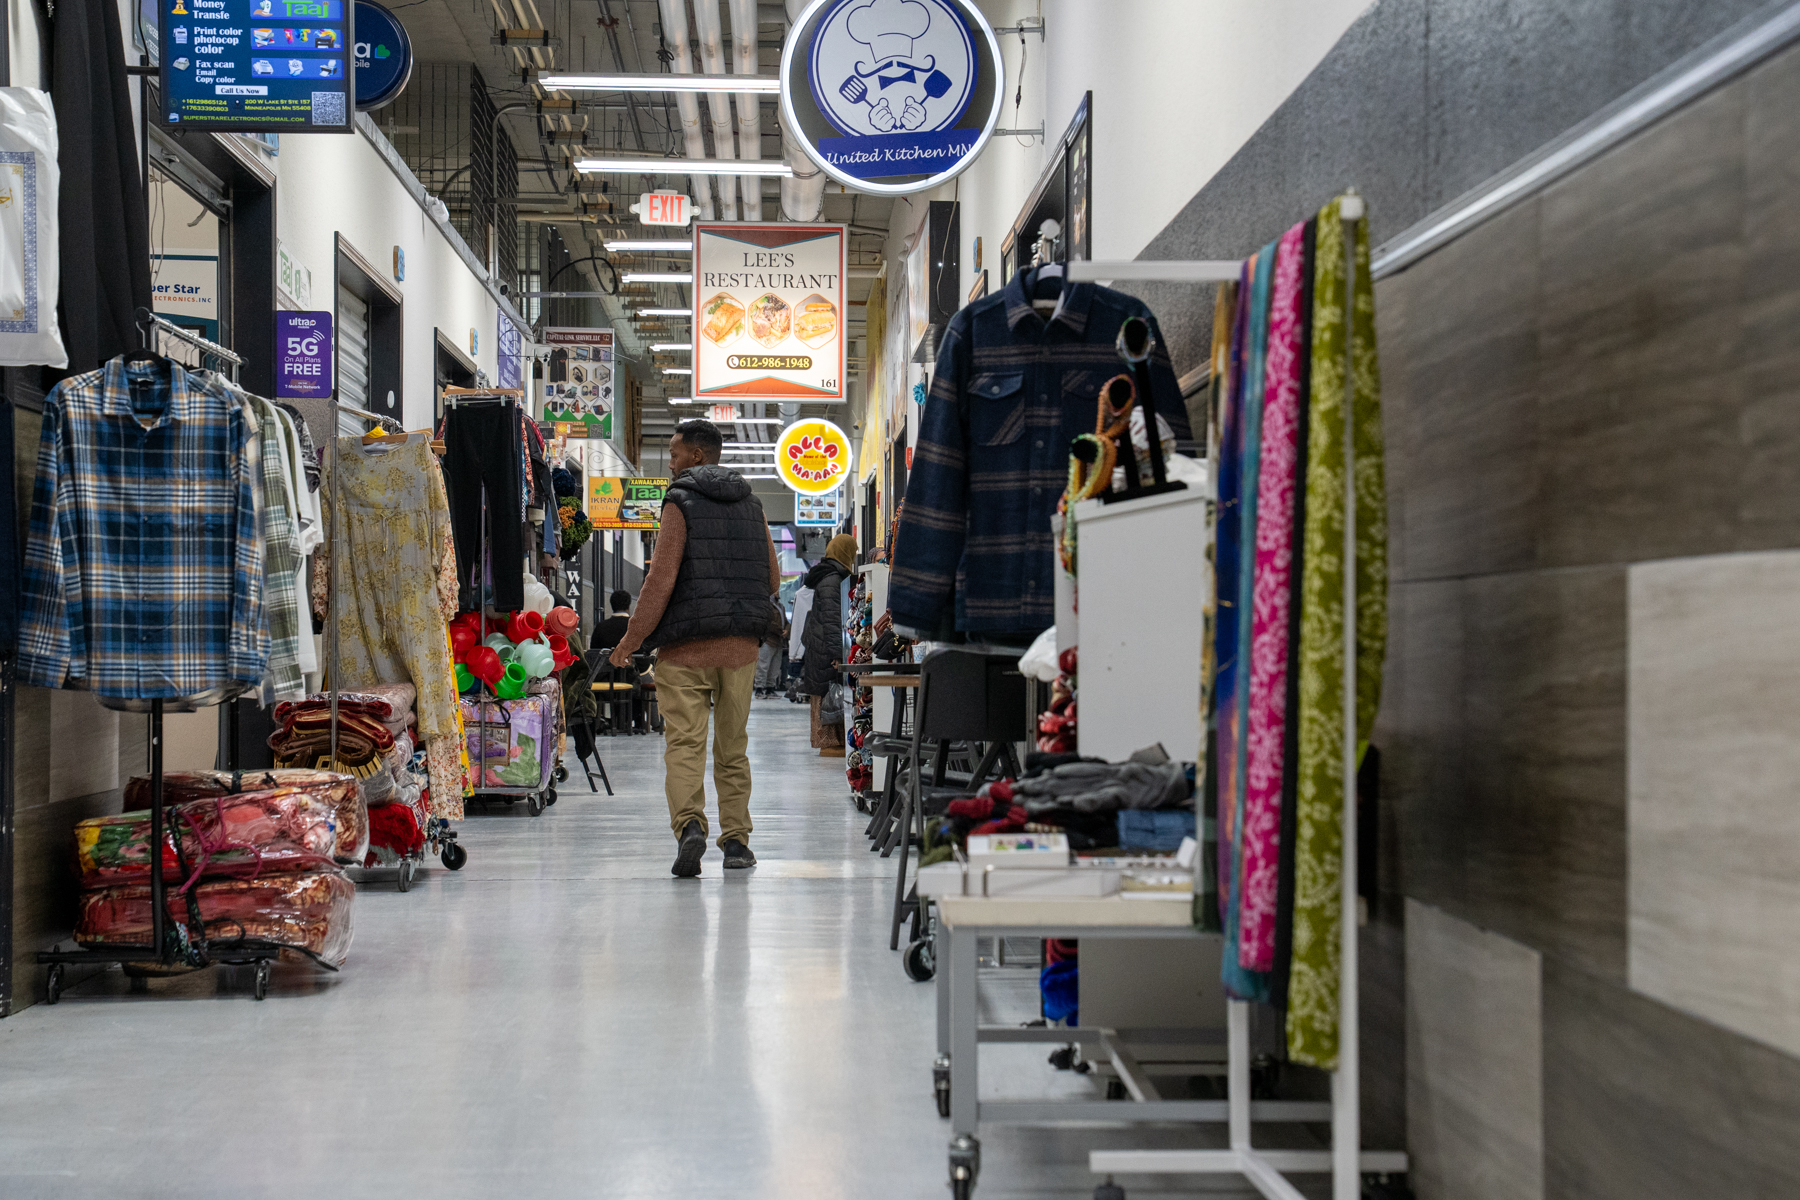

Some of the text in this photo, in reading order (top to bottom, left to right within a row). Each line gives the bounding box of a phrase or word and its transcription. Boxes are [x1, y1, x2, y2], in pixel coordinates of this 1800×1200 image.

[193, 0, 226, 11] Money
[282, 0, 330, 19] Taaj
[192, 10, 230, 20] Transfe
[193, 26, 243, 36] Print color
[193, 35, 240, 46] photocop
[194, 44, 224, 54] color
[195, 60, 235, 69] Fax scan
[195, 76, 236, 85] Copy color
[826, 143, 973, 165] United Kitchen MN
[648, 194, 685, 223] EXIT
[742, 252, 795, 268] LEE'S
[703, 273, 838, 289] RESTAURANT
[173, 283, 200, 294] Star
[288, 317, 310, 326] ultra
[287, 337, 319, 356] 5G
[739, 356, 810, 370] 612-986-1948
[284, 363, 321, 375] FREE
[820, 378, 837, 389] 161
[714, 405, 734, 421] EXIT
[629, 485, 667, 501] Taaj
[590, 496, 620, 504] IKRAN
